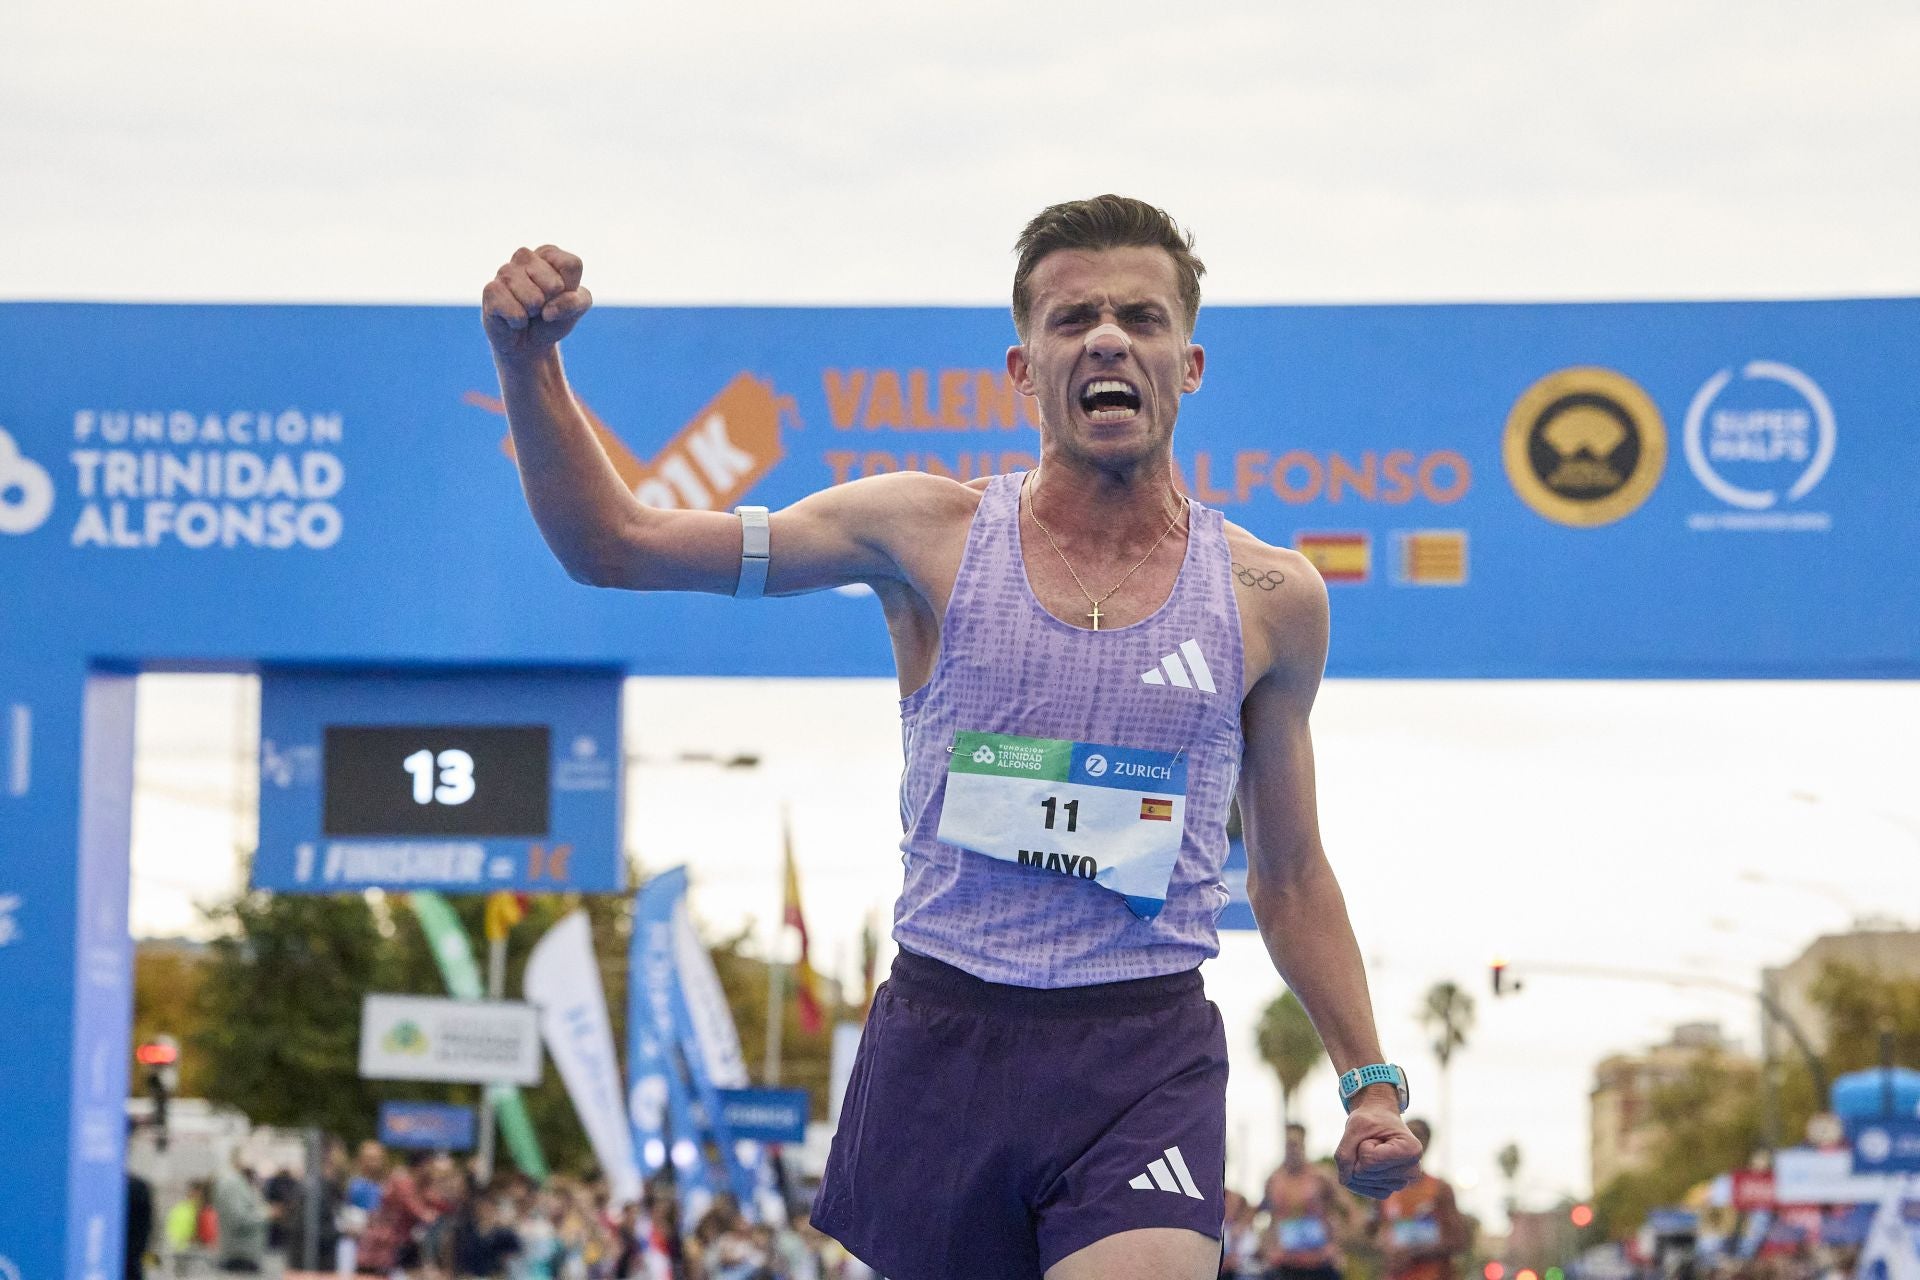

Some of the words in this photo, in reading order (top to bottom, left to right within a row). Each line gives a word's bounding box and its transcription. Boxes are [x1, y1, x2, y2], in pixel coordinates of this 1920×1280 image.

[71, 450, 344, 498] TRINIDAD
[71, 501, 343, 549] ALFONSO
[997, 760, 1042, 770] ALFONSO
[998, 751, 1043, 762] TRINIDAD
[1114, 762, 1171, 780] ZURICH
[403, 749, 476, 805] 13
[1041, 796, 1079, 832] 11
[1018, 849, 1097, 880] MAYO
